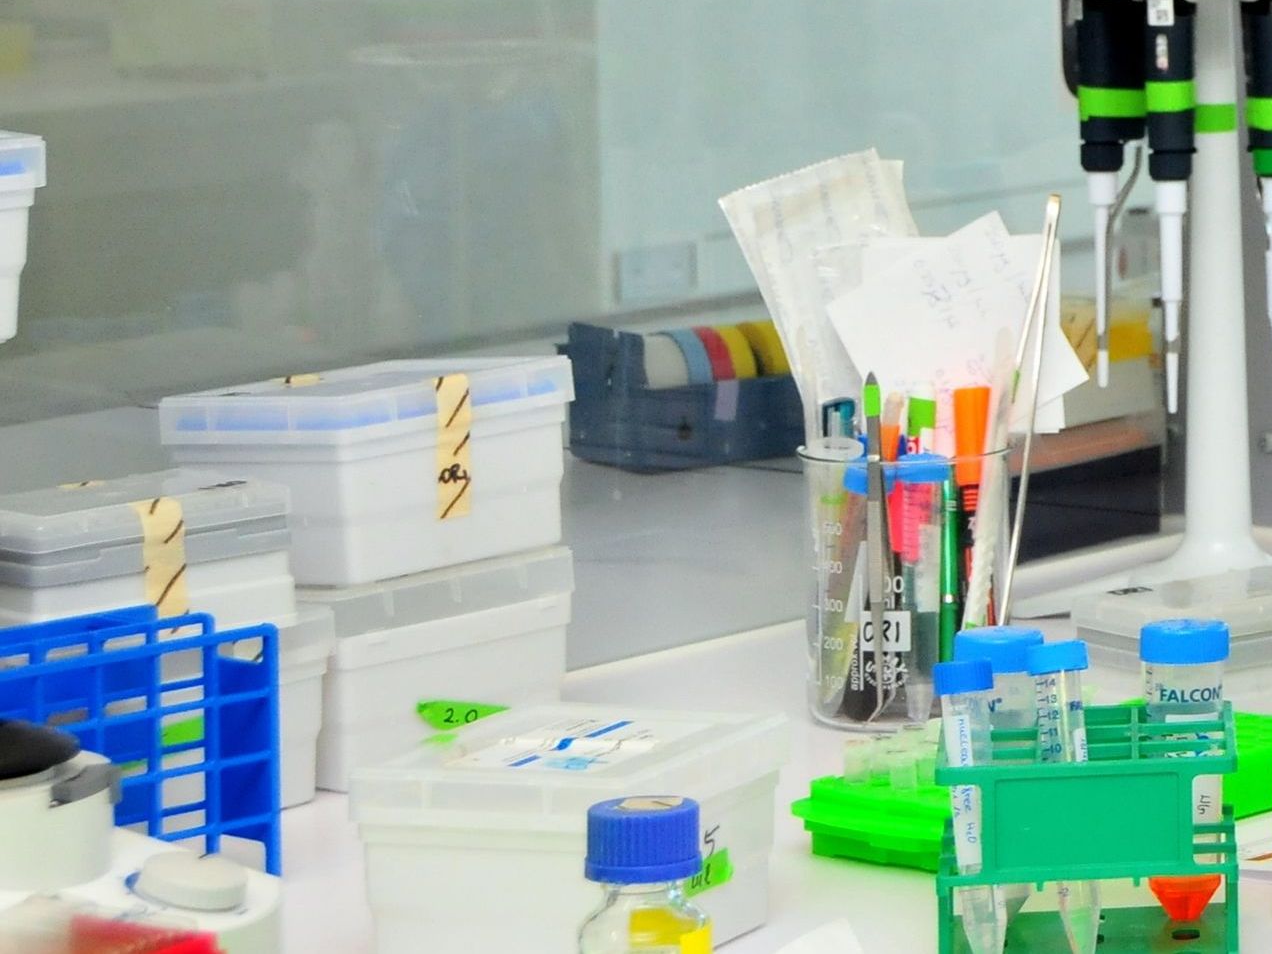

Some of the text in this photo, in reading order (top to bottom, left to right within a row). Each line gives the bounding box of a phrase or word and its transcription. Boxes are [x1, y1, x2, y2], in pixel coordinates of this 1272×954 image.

[823, 636, 844, 650] 200
[825, 675, 844, 689] 100
[1045, 678, 1056, 688] 14
[1047, 694, 1057, 704] 13
[1159, 687, 1221, 703] FALCON
[443, 708, 478, 724] 2.0
[1048, 710, 1059, 720] 12
[1051, 743, 1062, 754] 10
